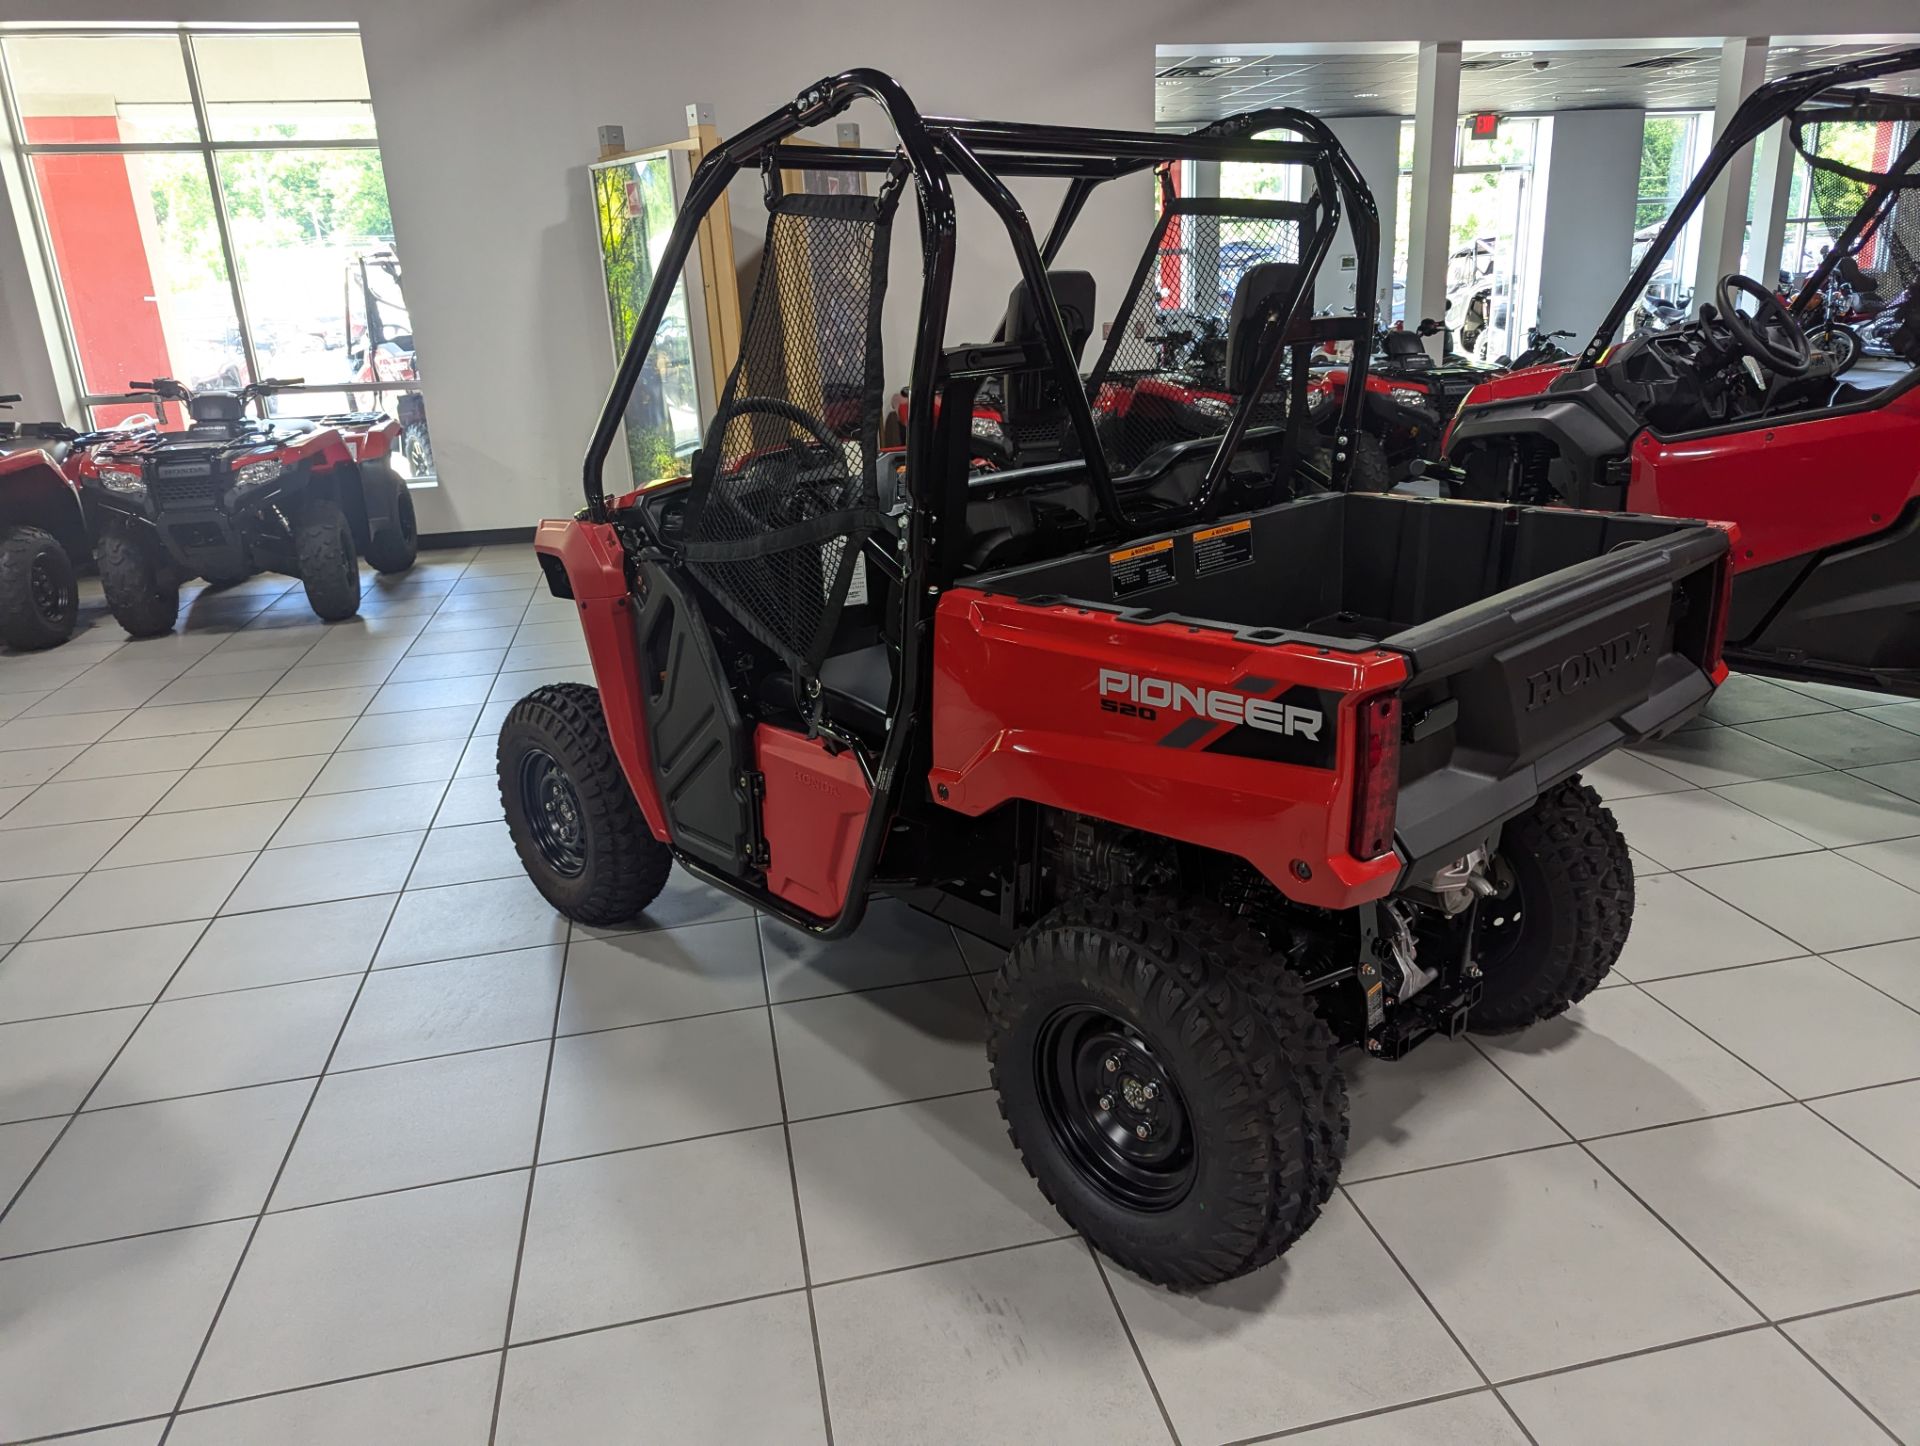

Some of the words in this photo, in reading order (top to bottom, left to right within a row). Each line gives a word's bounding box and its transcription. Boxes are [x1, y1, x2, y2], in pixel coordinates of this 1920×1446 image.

[1476, 115, 1496, 133] EXIT
[1525, 622, 1651, 712] HONDA
[1099, 668, 1323, 742] PIONEER
[1100, 699, 1156, 721] 520
[792, 769, 842, 799] HONDA
